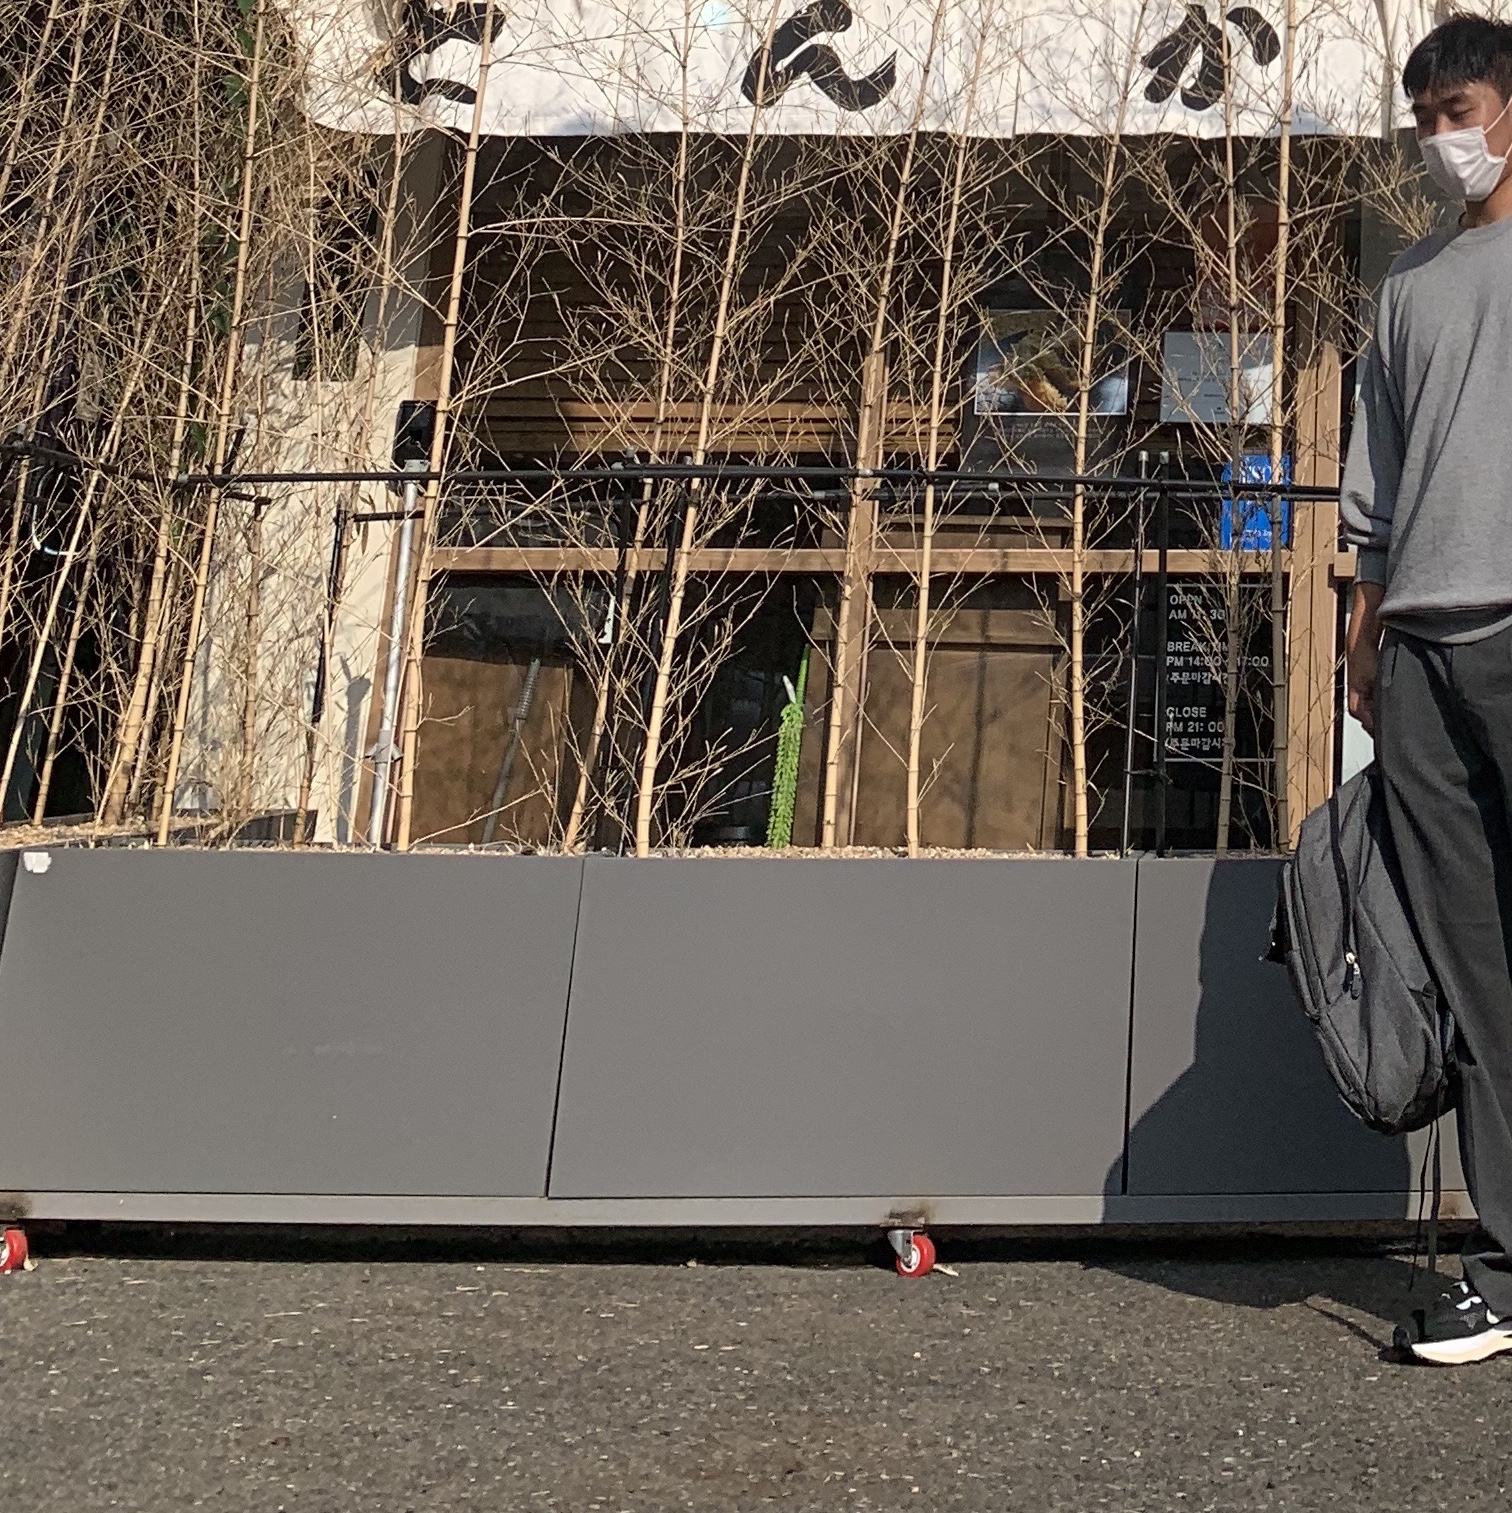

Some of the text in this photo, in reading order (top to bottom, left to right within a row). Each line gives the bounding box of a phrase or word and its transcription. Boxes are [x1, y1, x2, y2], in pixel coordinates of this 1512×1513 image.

[1168, 609, 1187, 620] AM
[1166, 641, 1208, 653] BREAK
[1165, 655, 1185, 667] PM
[1166, 706, 1207, 718] CLOSE
